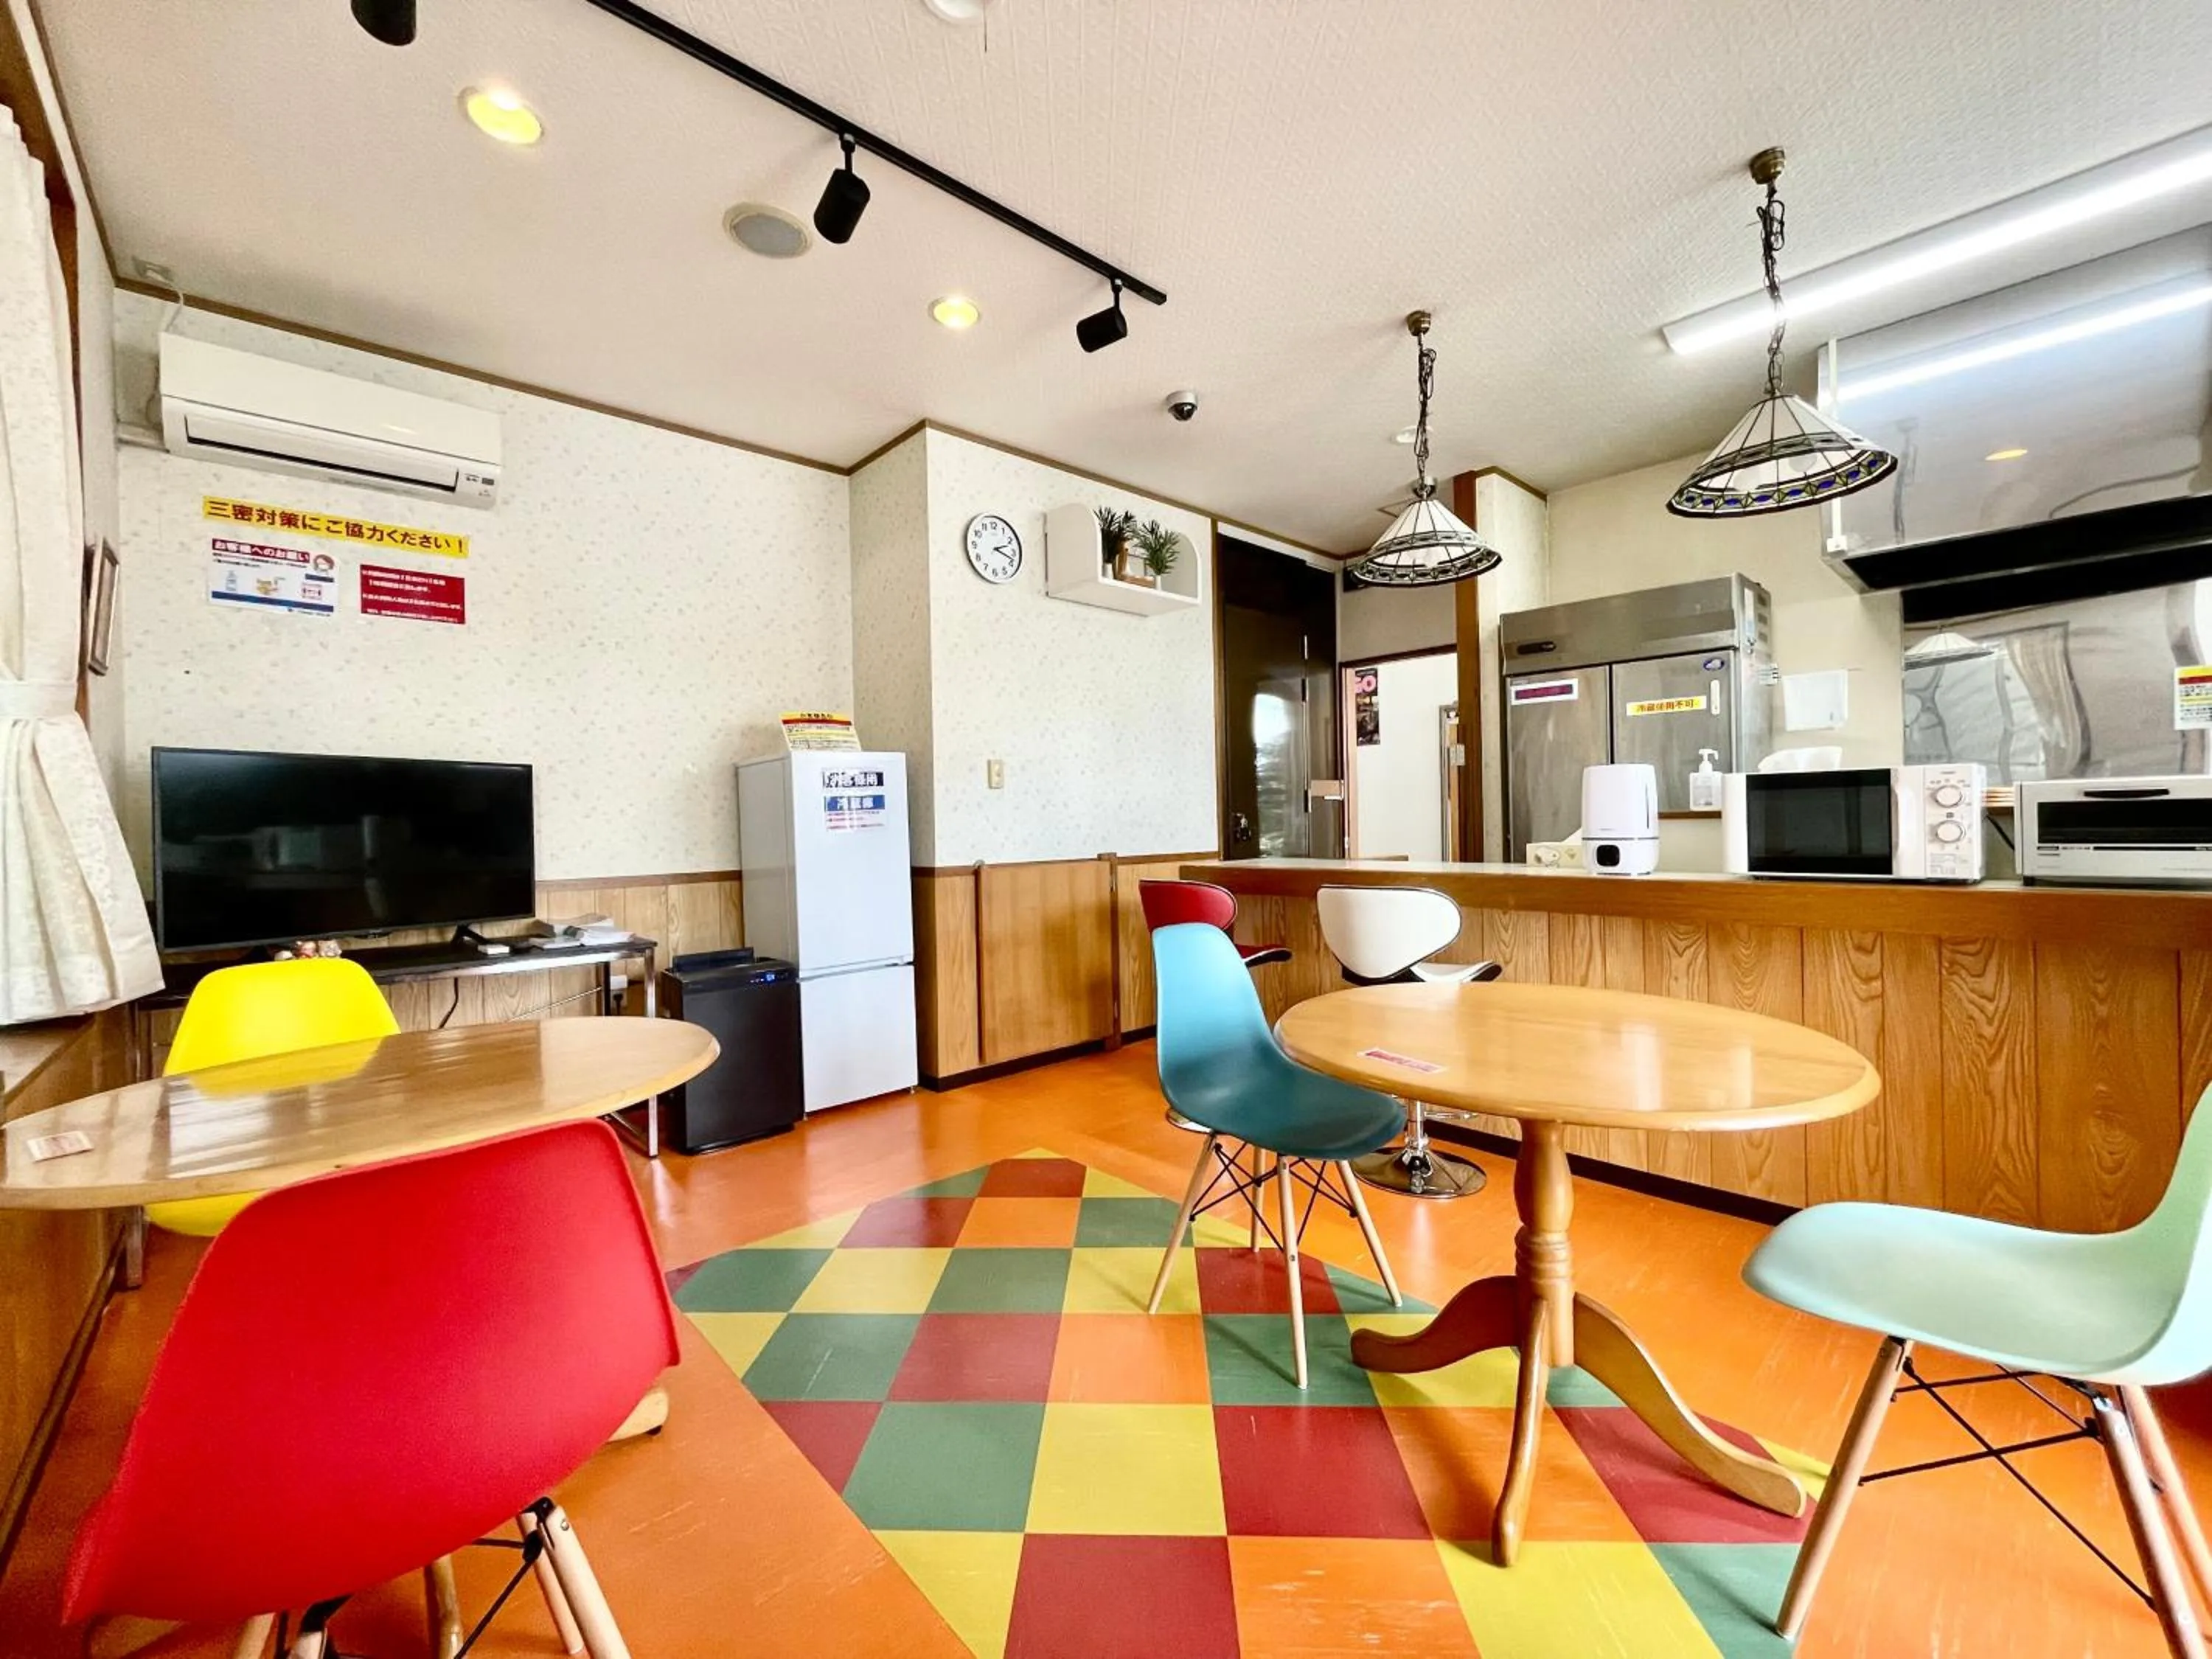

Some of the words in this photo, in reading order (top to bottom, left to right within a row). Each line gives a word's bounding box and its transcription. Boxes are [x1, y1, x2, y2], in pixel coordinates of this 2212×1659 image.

[981, 523, 987, 531] 11
[990, 521, 998, 530] 12
[1007, 536, 1013, 545] 2
[983, 563, 989, 571] 7
